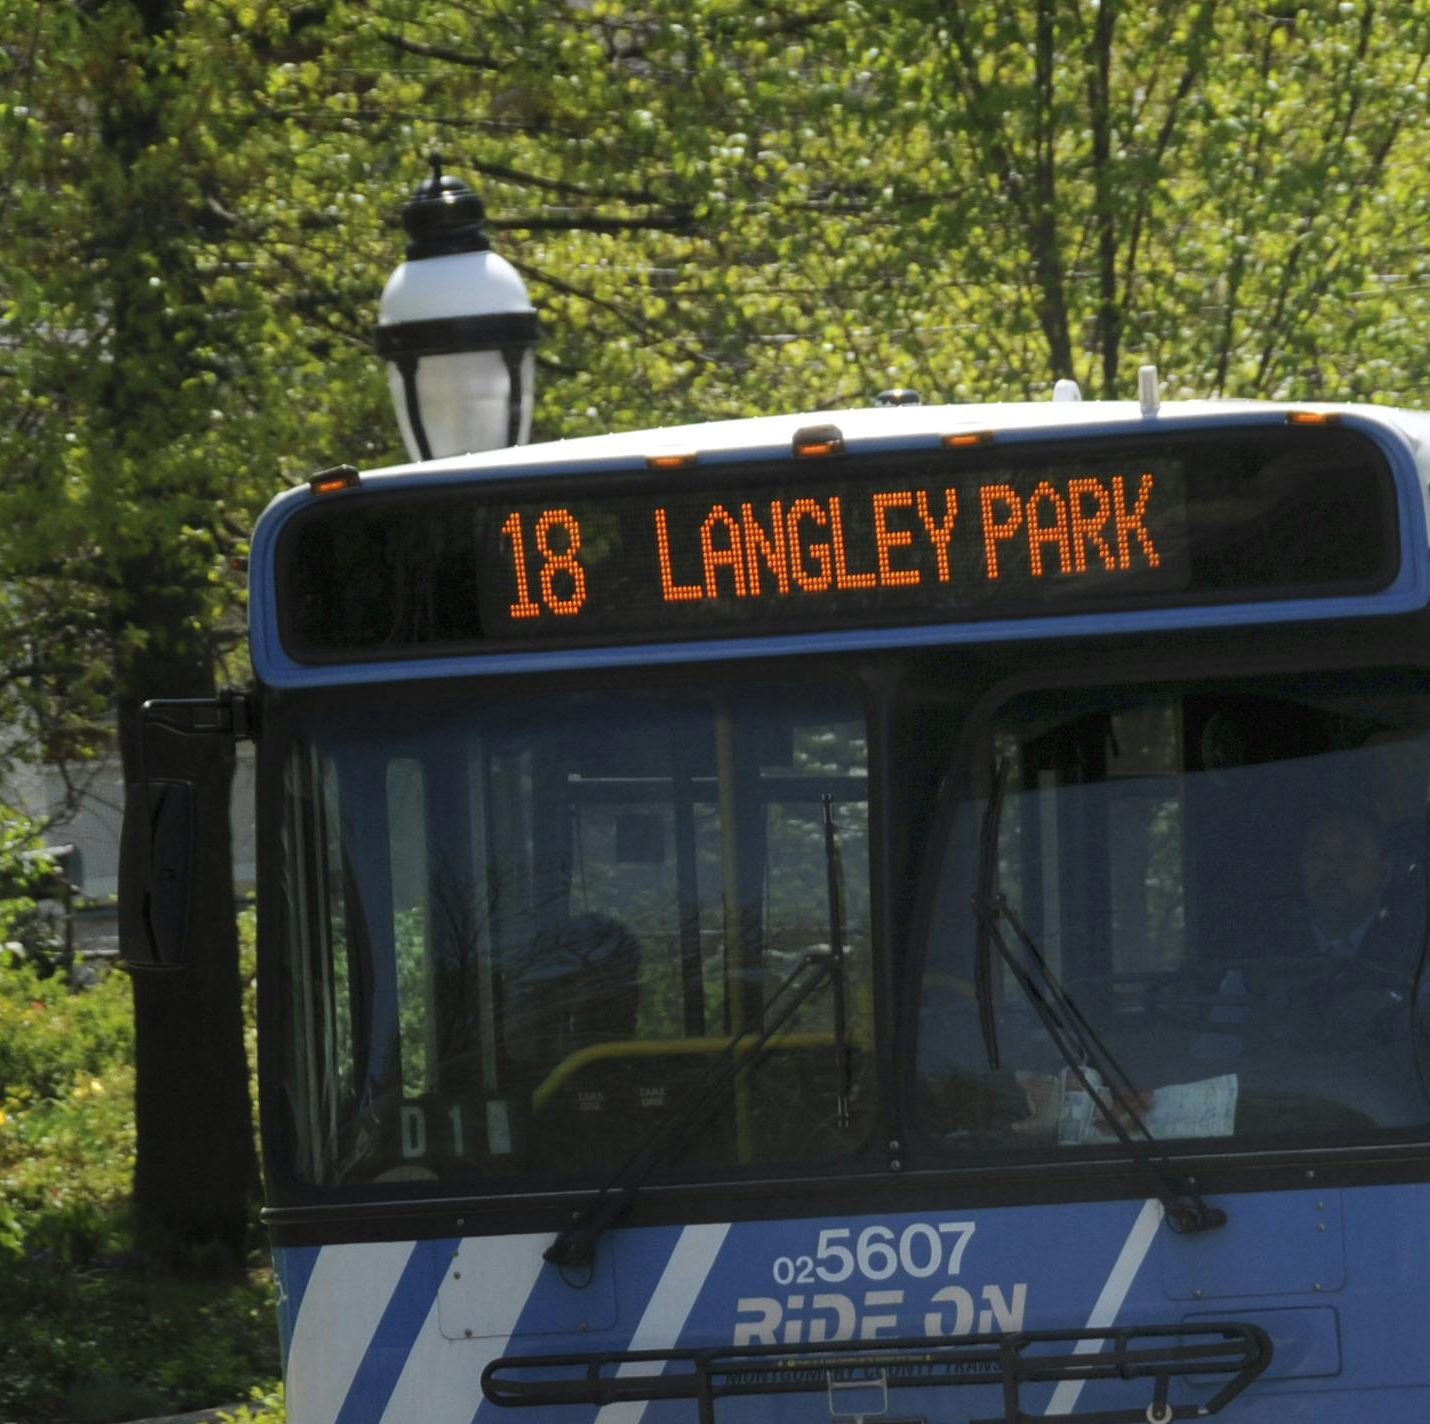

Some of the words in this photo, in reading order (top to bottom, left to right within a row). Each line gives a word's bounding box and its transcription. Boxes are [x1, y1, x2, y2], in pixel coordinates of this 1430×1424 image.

[501, 509, 587, 618] 18
[654, 487, 958, 601] LANGLEY
[980, 473, 1161, 580] PARK
[732, 1290, 905, 1356] RIDE
[922, 1282, 1027, 1350] ON
